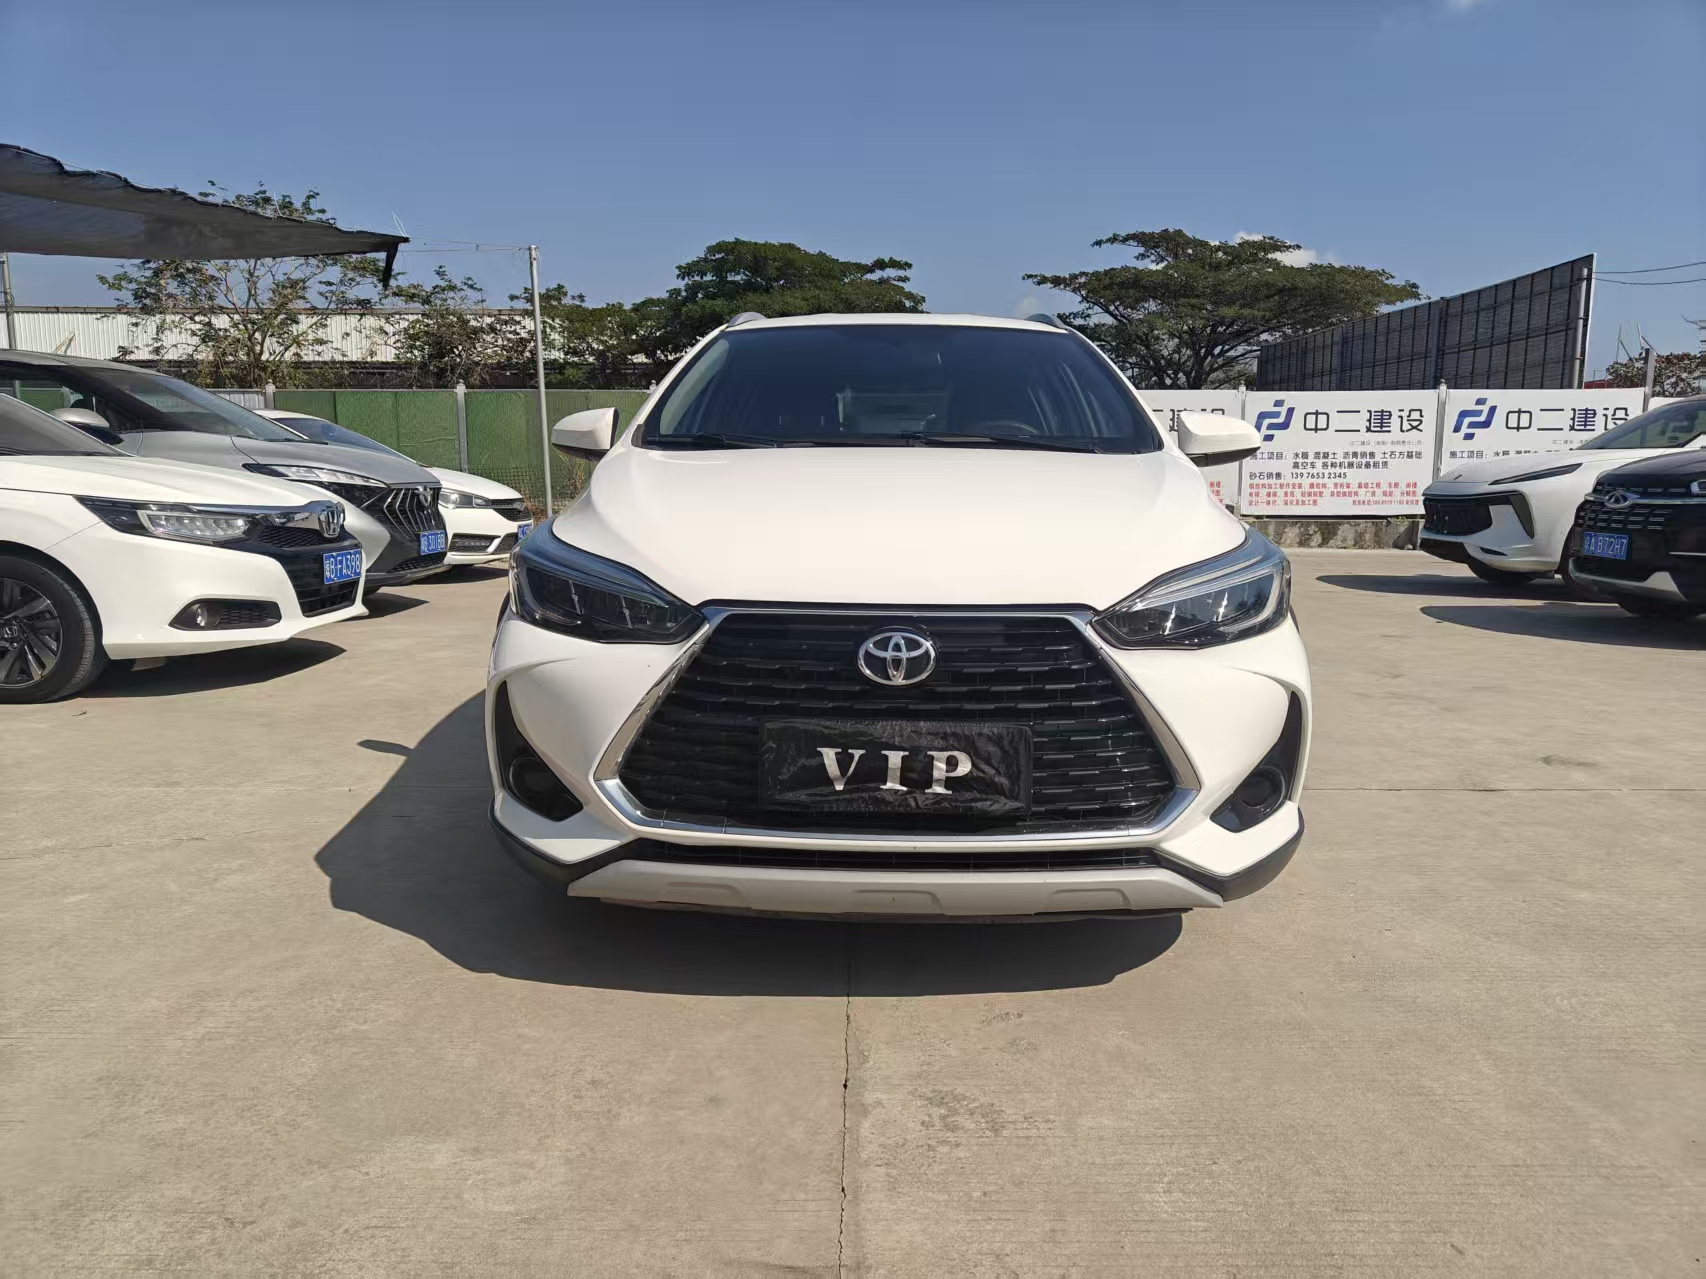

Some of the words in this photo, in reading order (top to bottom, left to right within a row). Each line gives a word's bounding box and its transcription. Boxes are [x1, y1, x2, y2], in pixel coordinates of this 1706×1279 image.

[1303, 408, 1424, 433] 中二建设
[1505, 407, 1630, 432] 中二建设
[816, 747, 973, 794] VIP
